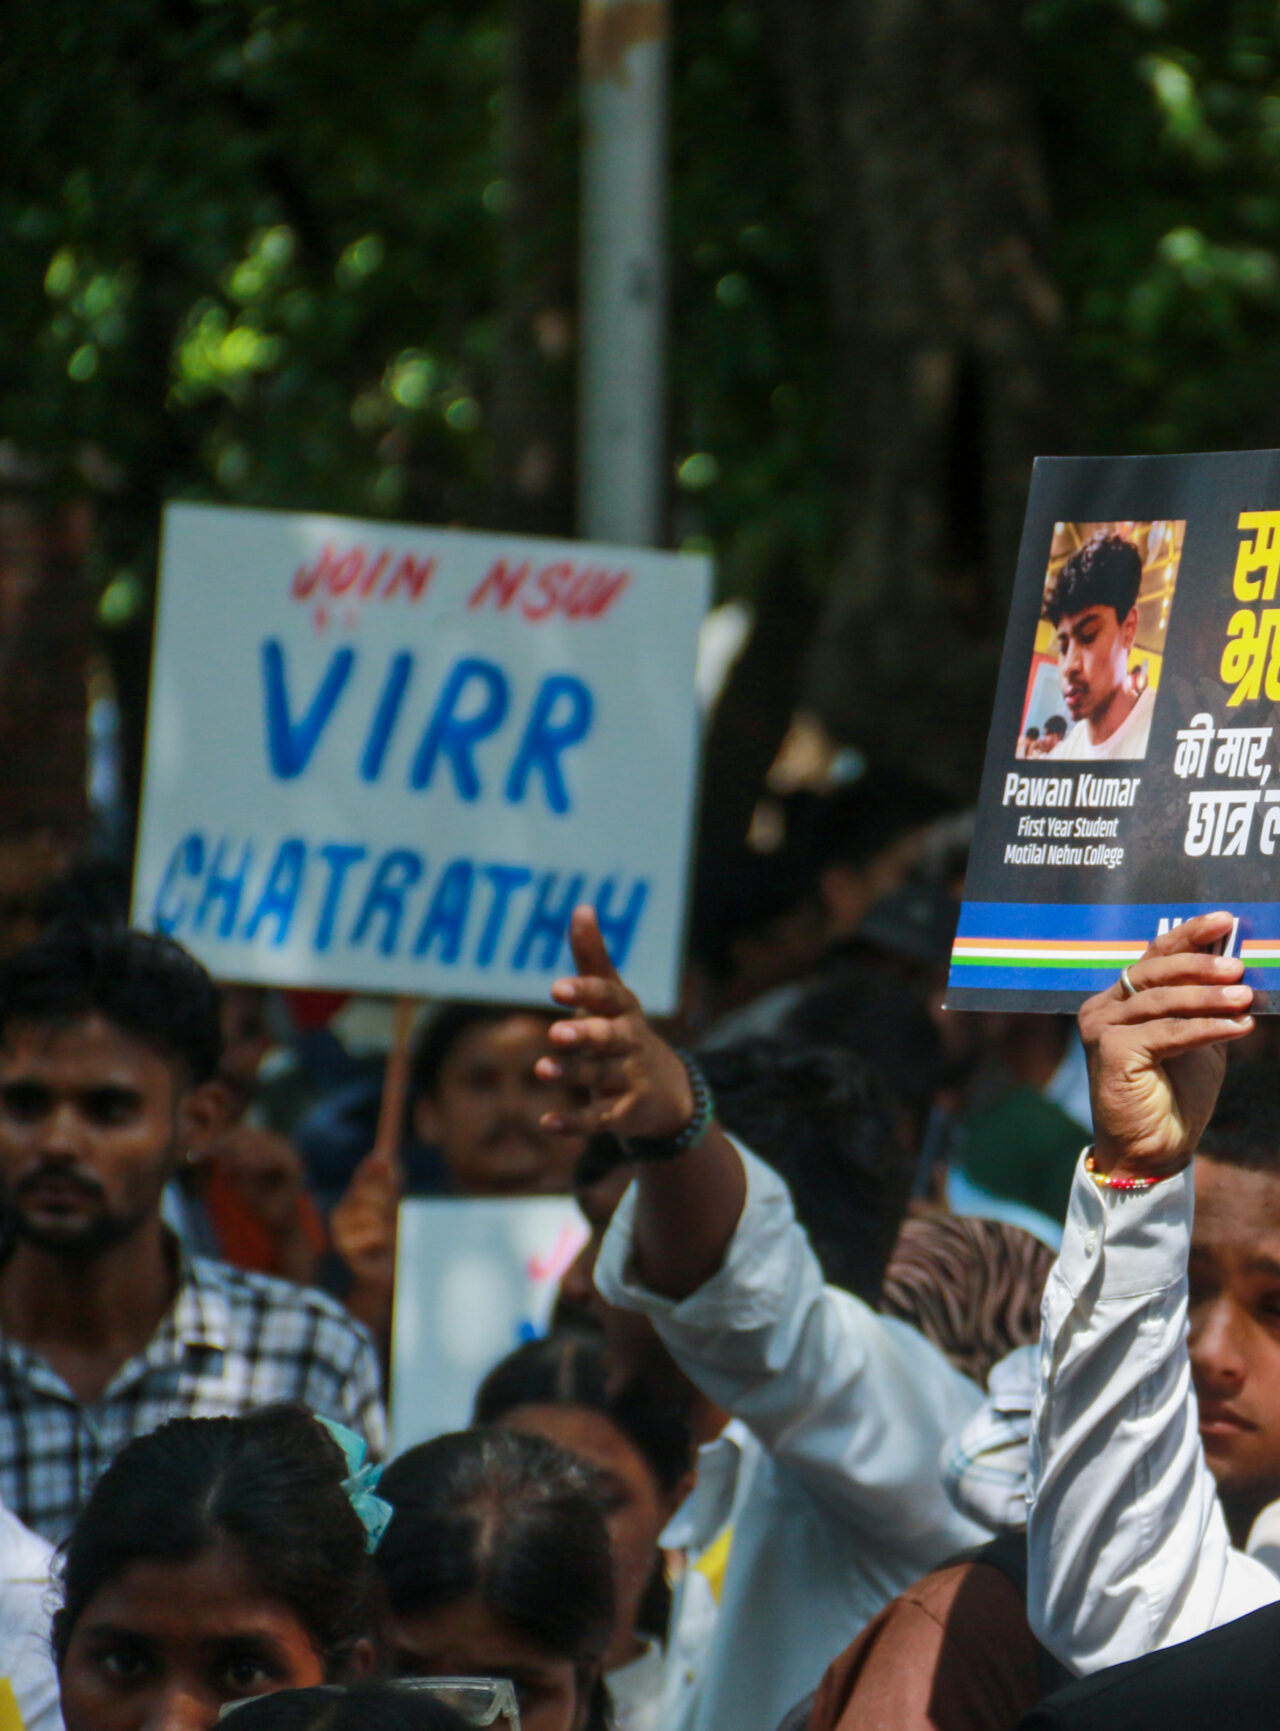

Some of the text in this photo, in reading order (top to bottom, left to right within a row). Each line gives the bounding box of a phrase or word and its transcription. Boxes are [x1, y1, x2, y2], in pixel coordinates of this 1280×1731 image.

[291, 541, 438, 605] JOIN
[260, 637, 595, 815] VIRR
[1173, 712, 1216, 779] की
[1213, 727, 1274, 786] मार,
[1002, 772, 1141, 807] Pawan Kumar
[1017, 815, 1119, 838] First Year Student
[1184, 790, 1262, 857] छात्र
[1003, 843, 1124, 869] Motilal Nehru College
